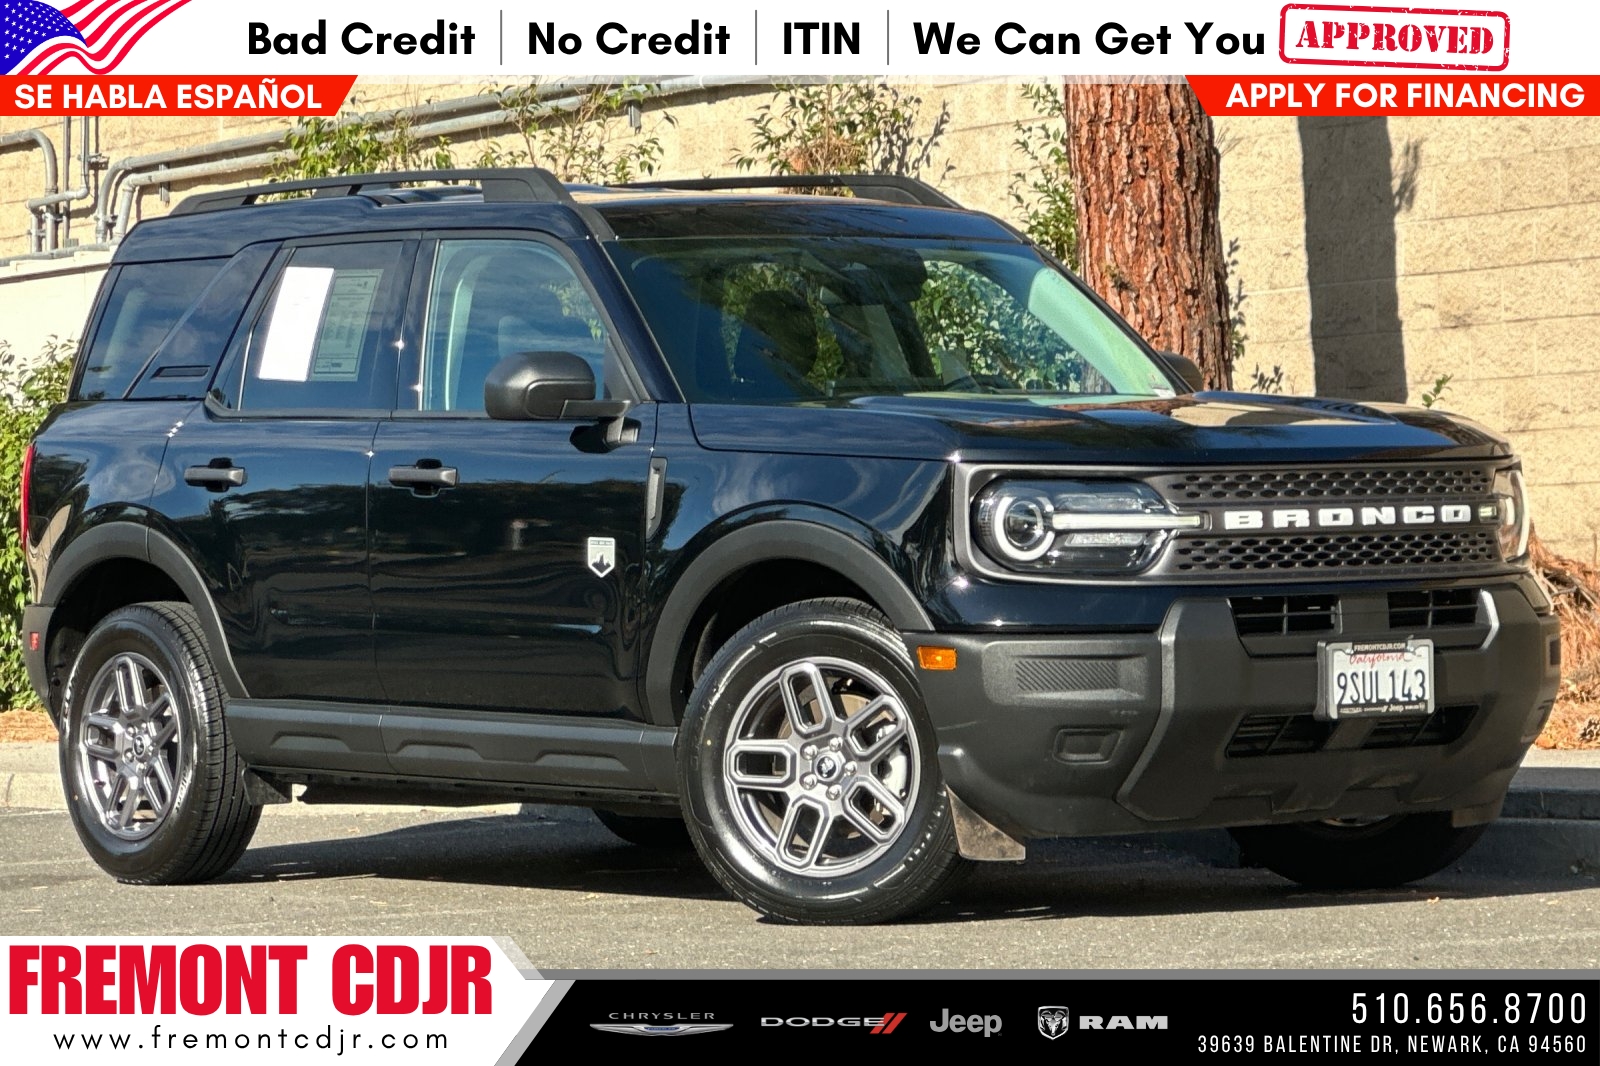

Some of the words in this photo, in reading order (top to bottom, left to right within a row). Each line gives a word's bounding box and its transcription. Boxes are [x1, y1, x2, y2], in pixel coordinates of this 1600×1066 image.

[1223, 504, 1472, 530] BRONCO
[1349, 652, 1405, 669] California
[1336, 668, 1426, 705] 9SUL143
